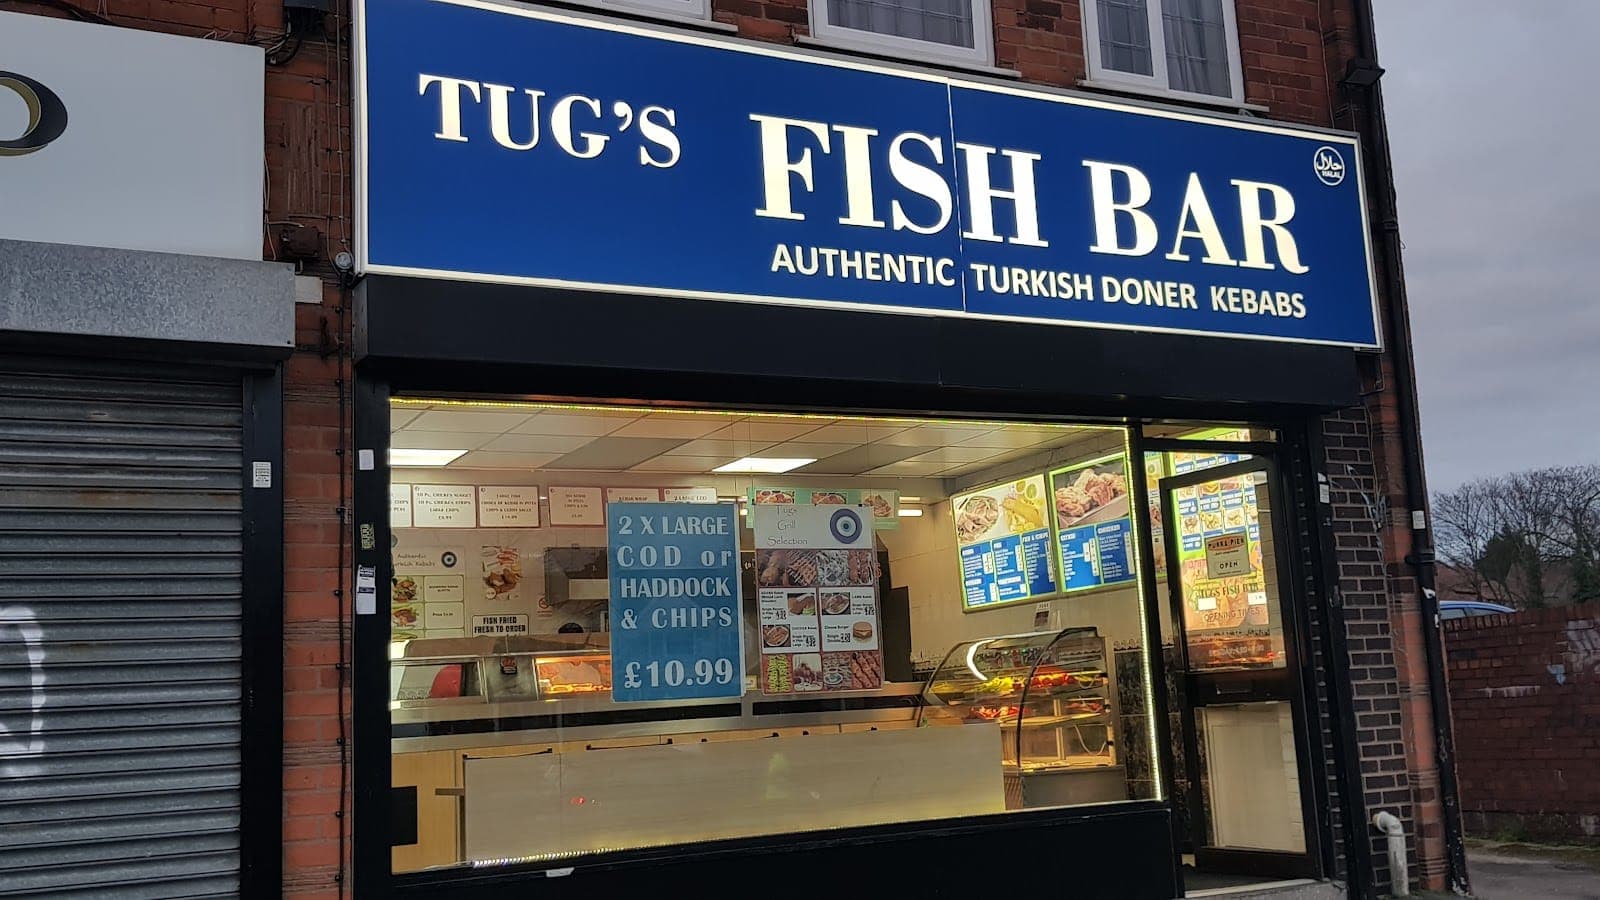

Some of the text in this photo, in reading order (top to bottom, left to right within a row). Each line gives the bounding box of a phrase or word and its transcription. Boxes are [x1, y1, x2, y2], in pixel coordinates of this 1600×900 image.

[419, 73, 1309, 274] TUG'S FISH BAR
[771, 243, 1306, 318] AUTHENTIC TURKISH DONER KEBABS
[618, 515, 729, 535] 2 X LARGE
[767, 536, 808, 547] Selection
[616, 545, 682, 567] COD
[700, 550, 732, 567] or
[1219, 561, 1239, 570] OPEN
[621, 577, 731, 598] HADDOCK
[621, 606, 732, 630] & CHIPS
[624, 658, 734, 689] £10.99
